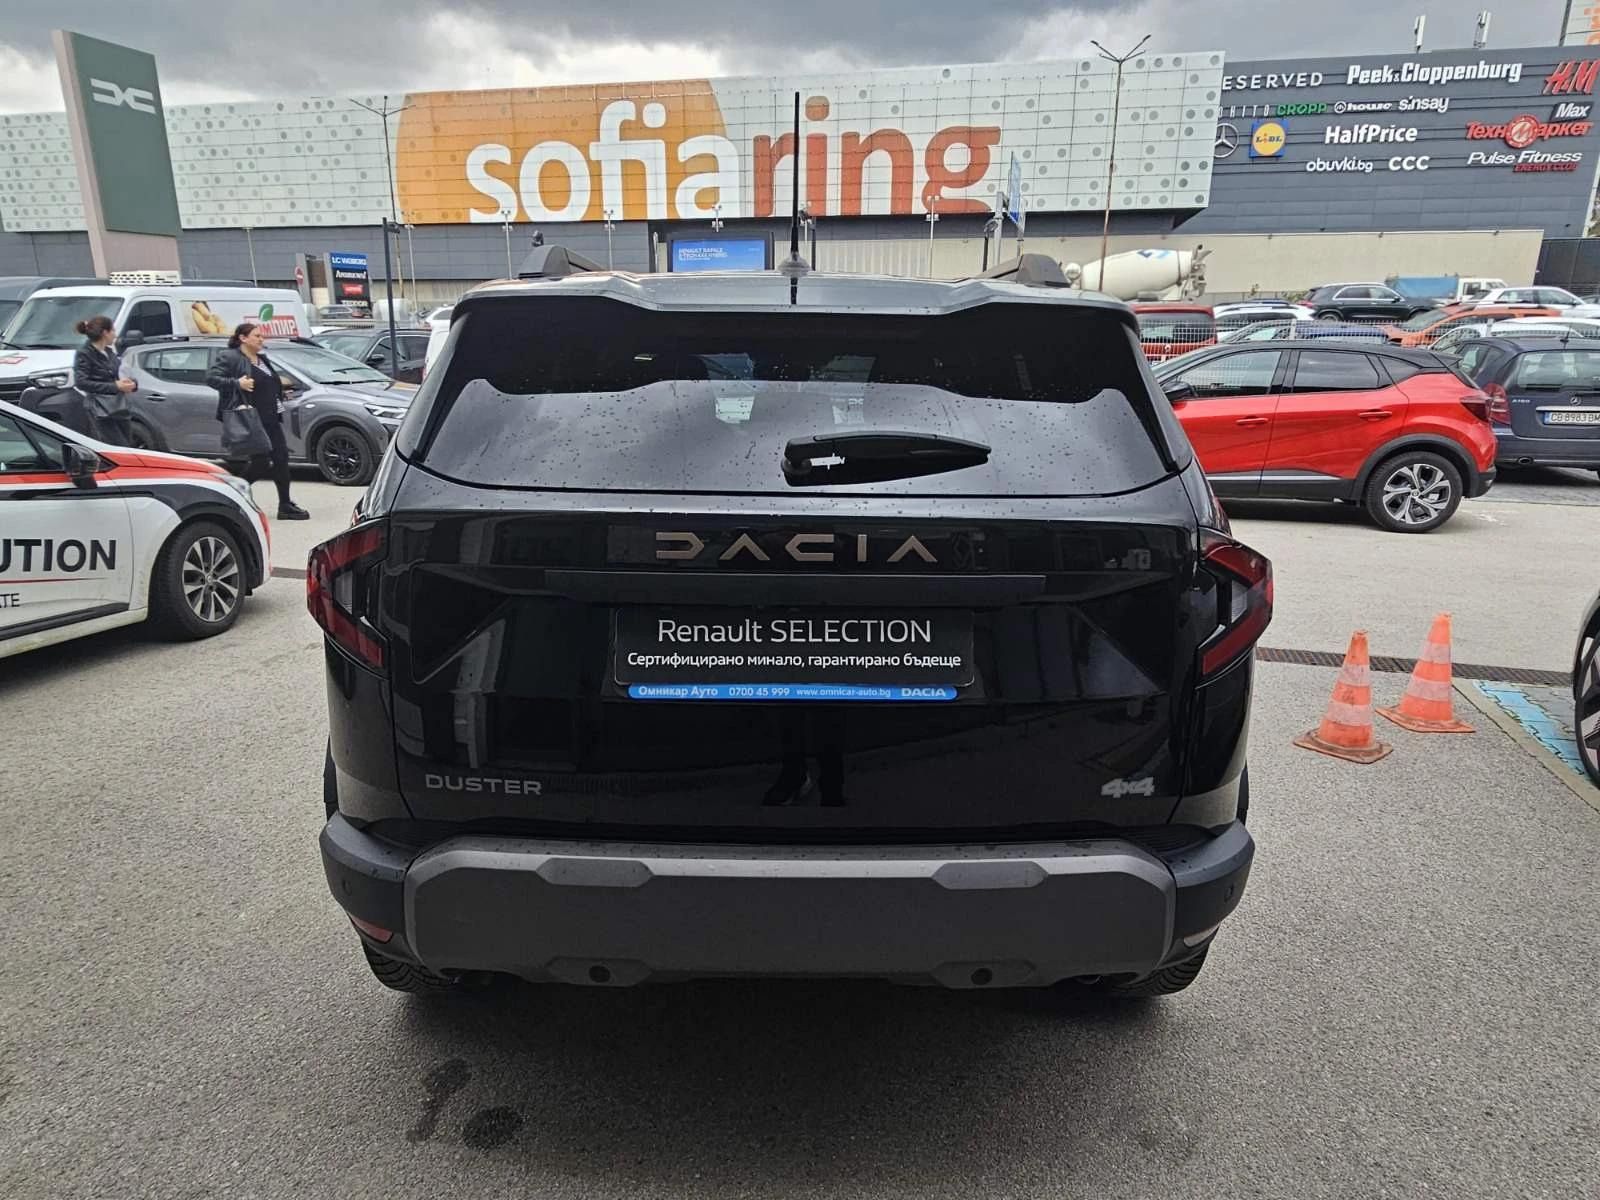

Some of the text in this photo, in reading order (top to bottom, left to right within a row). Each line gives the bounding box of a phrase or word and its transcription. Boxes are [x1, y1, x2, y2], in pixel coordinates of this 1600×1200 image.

[1222, 72, 1323, 90] ESERVED
[1542, 59, 1600, 95] H&M
[1276, 102, 1327, 117] CROPP
[1398, 95, 1450, 114] sinsay
[1555, 102, 1591, 118] Max
[1324, 123, 1418, 145] HalfPrice
[1306, 156, 1374, 173] obuvki.bg
[1388, 155, 1431, 171] CCC
[1466, 150, 1584, 165] Pulse Fitness
[655, 531, 939, 562] DACIA
[657, 618, 932, 643] Renault SELECTION
[627, 652, 961, 668] Сертифицирано минало, гарантирано бъдеще
[638, 686, 719, 698] Омникар Ауто
[728, 687, 790, 696] 0700 45 999
[796, 688, 891, 698] www.omnicar-auto.bg
[901, 687, 946, 697] DACIA
[425, 774, 542, 795] DUSTER
